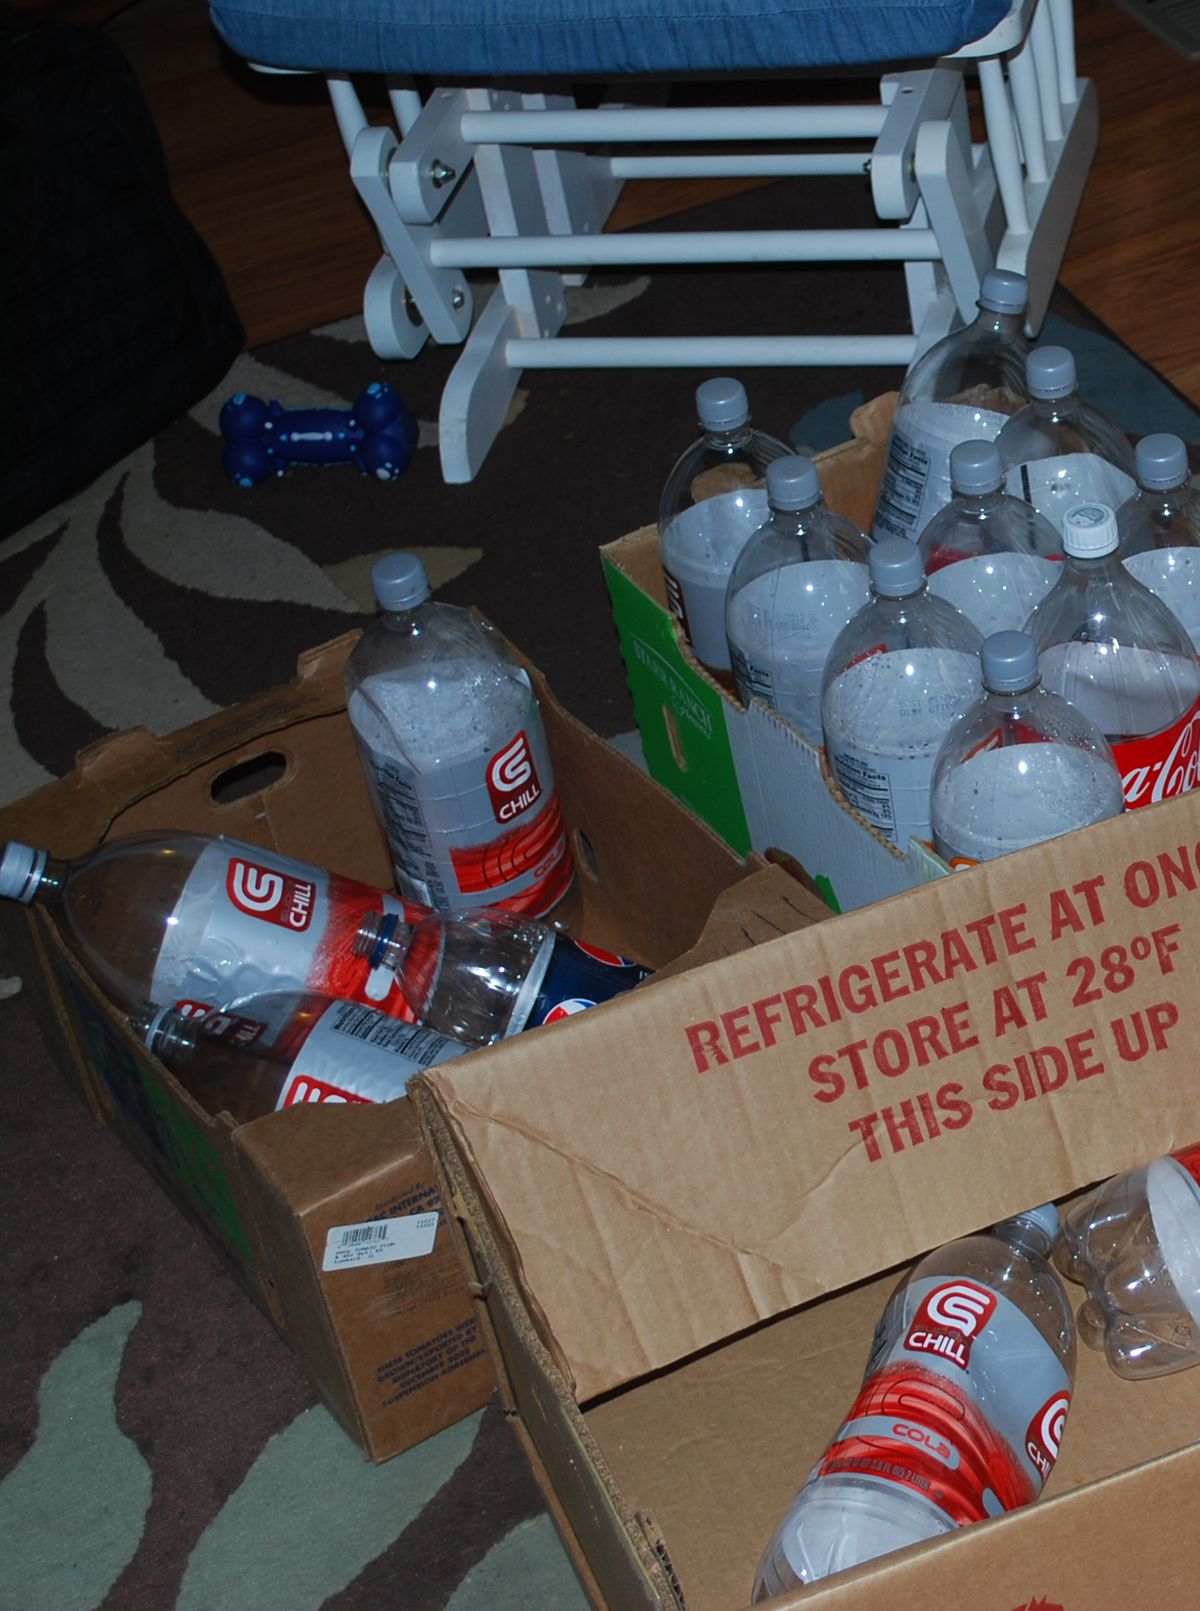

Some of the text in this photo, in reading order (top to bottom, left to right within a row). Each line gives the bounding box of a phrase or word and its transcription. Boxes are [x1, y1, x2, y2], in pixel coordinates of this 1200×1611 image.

[499, 785, 540, 820] CHILL
[289, 884, 311, 927] CHILL
[685, 903, 1036, 1073] REFRIGERATE
[1050, 875, 1105, 941] AT
[808, 1001, 979, 1103] STORE
[993, 971, 1048, 1037] AT
[848, 1002, 1180, 1162] THIS SIDE UP
[909, 1331, 966, 1365] CHILL
[892, 1423, 954, 1461] COLA
